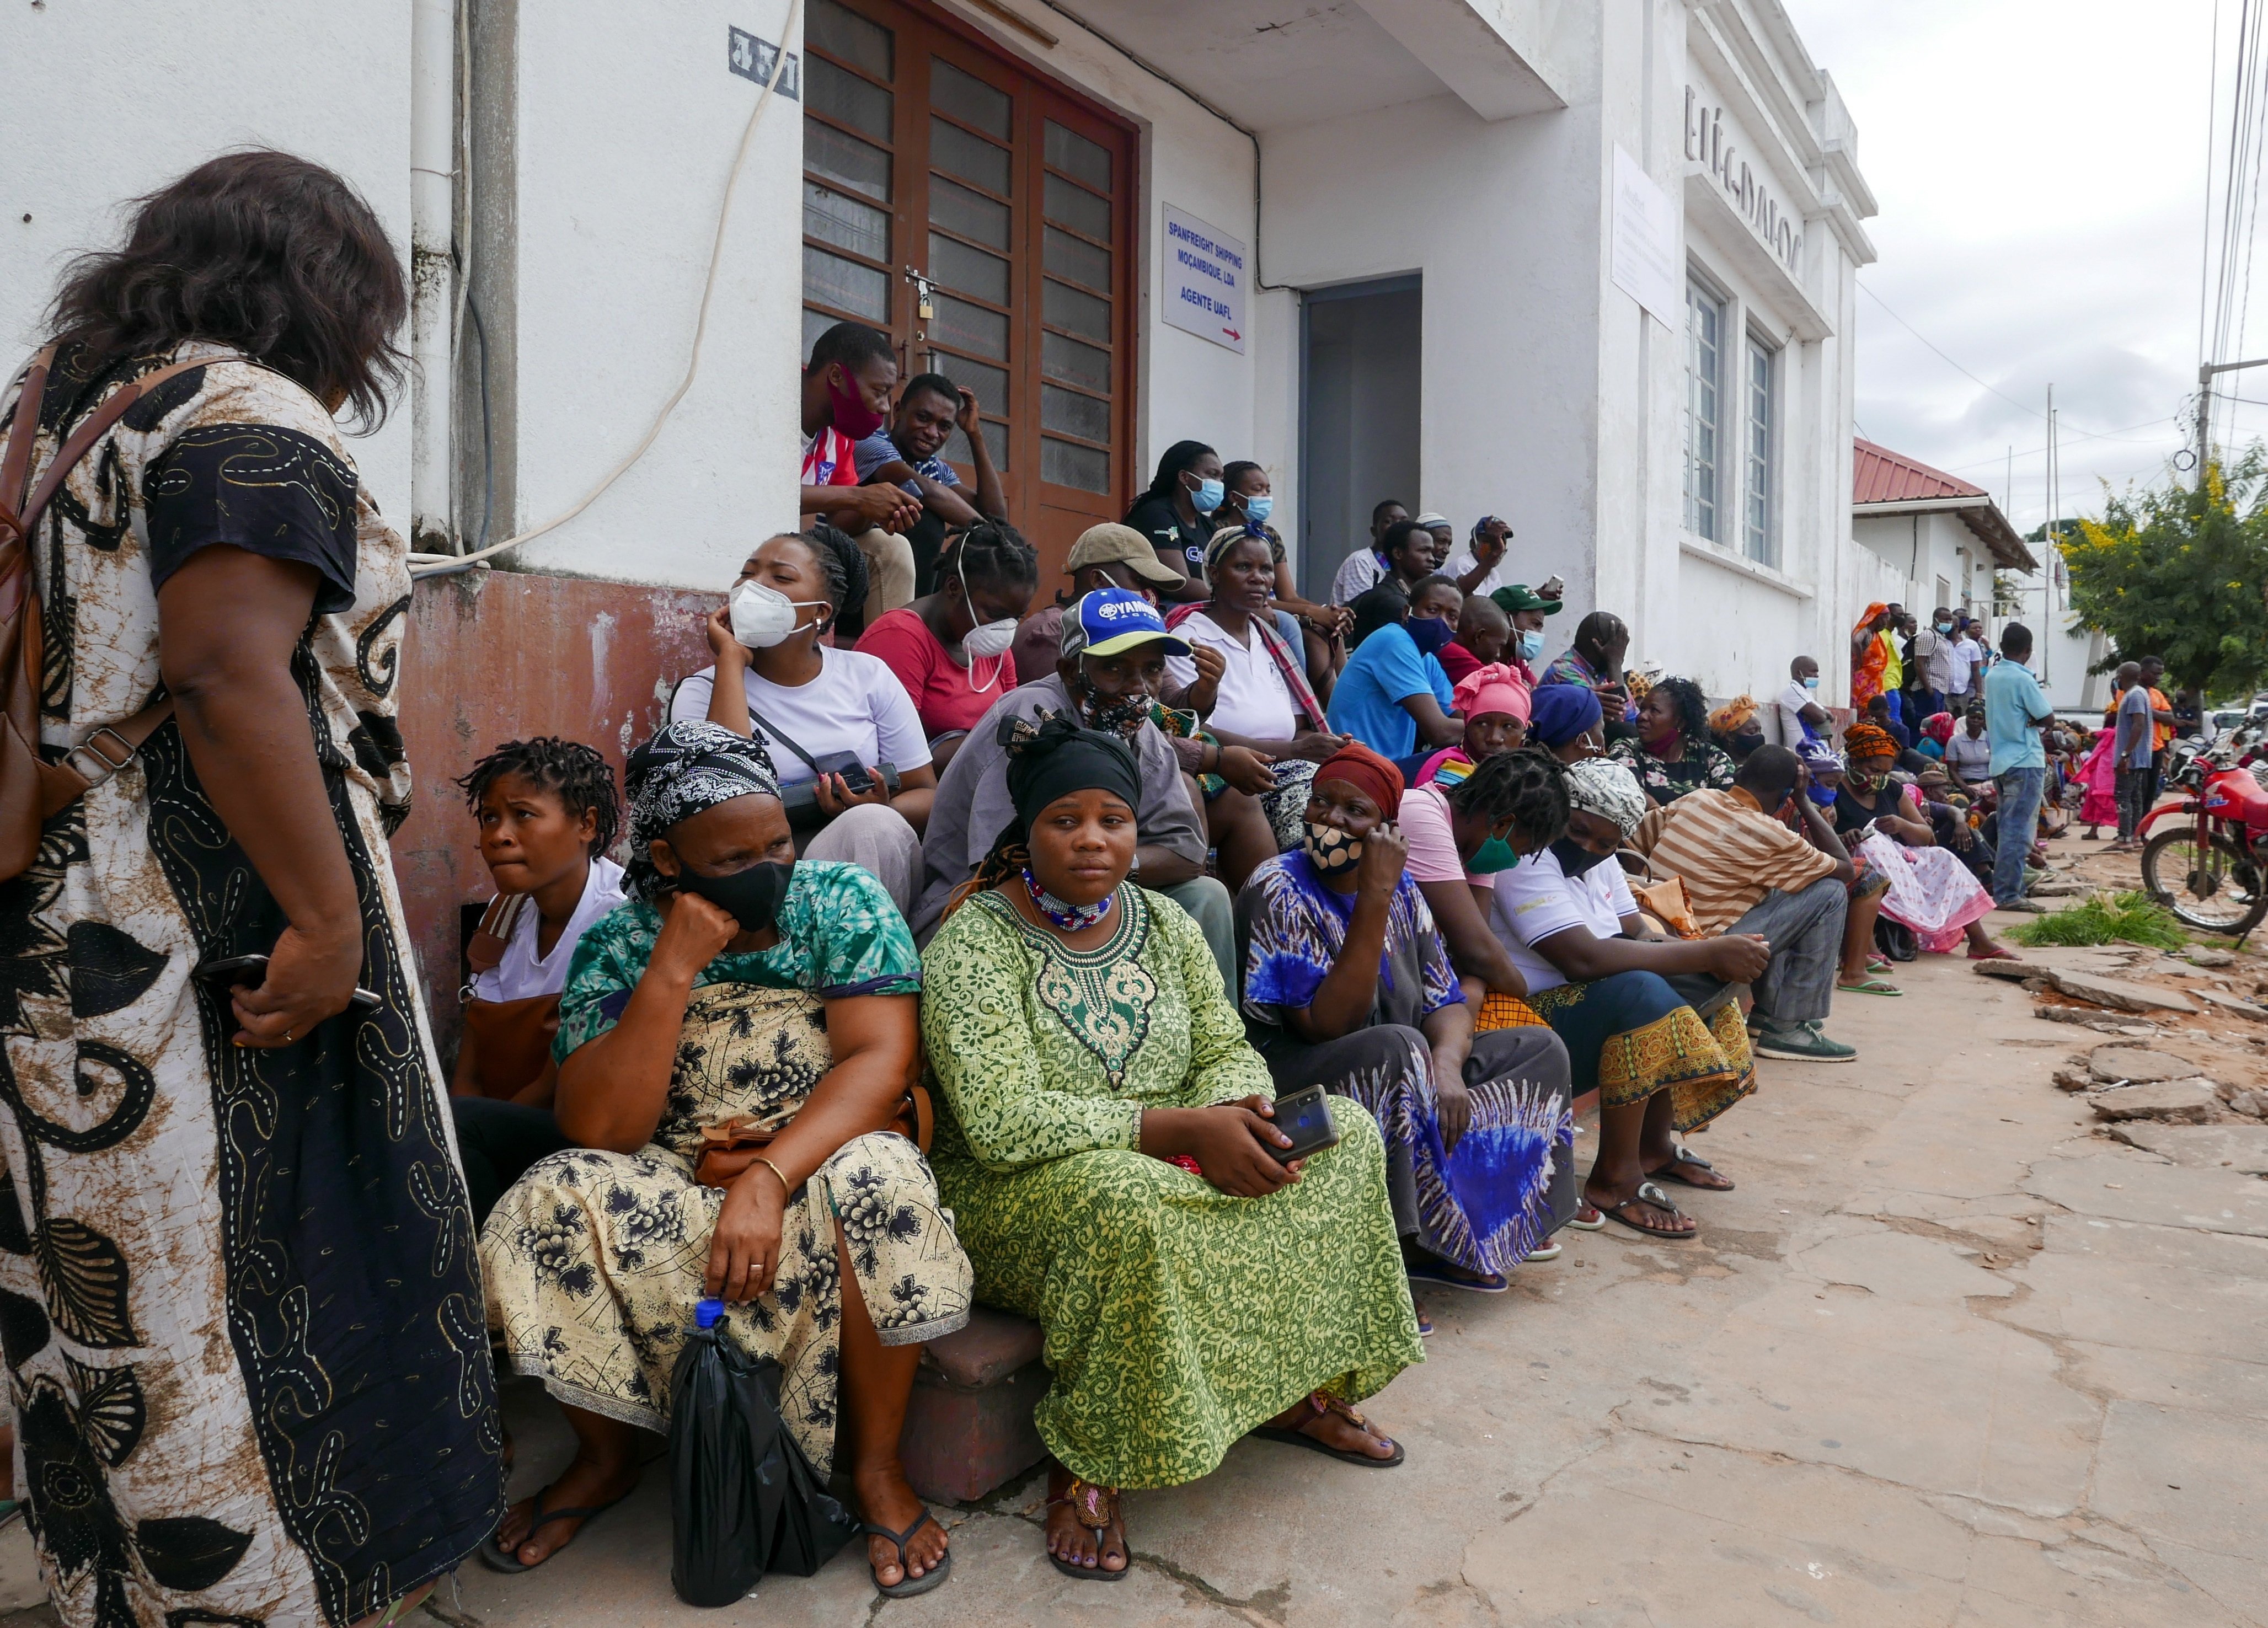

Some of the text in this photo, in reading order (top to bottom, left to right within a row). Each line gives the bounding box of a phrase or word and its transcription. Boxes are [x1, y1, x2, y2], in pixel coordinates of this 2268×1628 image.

[1169, 221, 1242, 270] SPANFREIGHT SHIPPING
[1178, 249, 1235, 288] MOÇAMBIQUE, LDA
[1180, 286, 1232, 320] AGENTE UAFL
